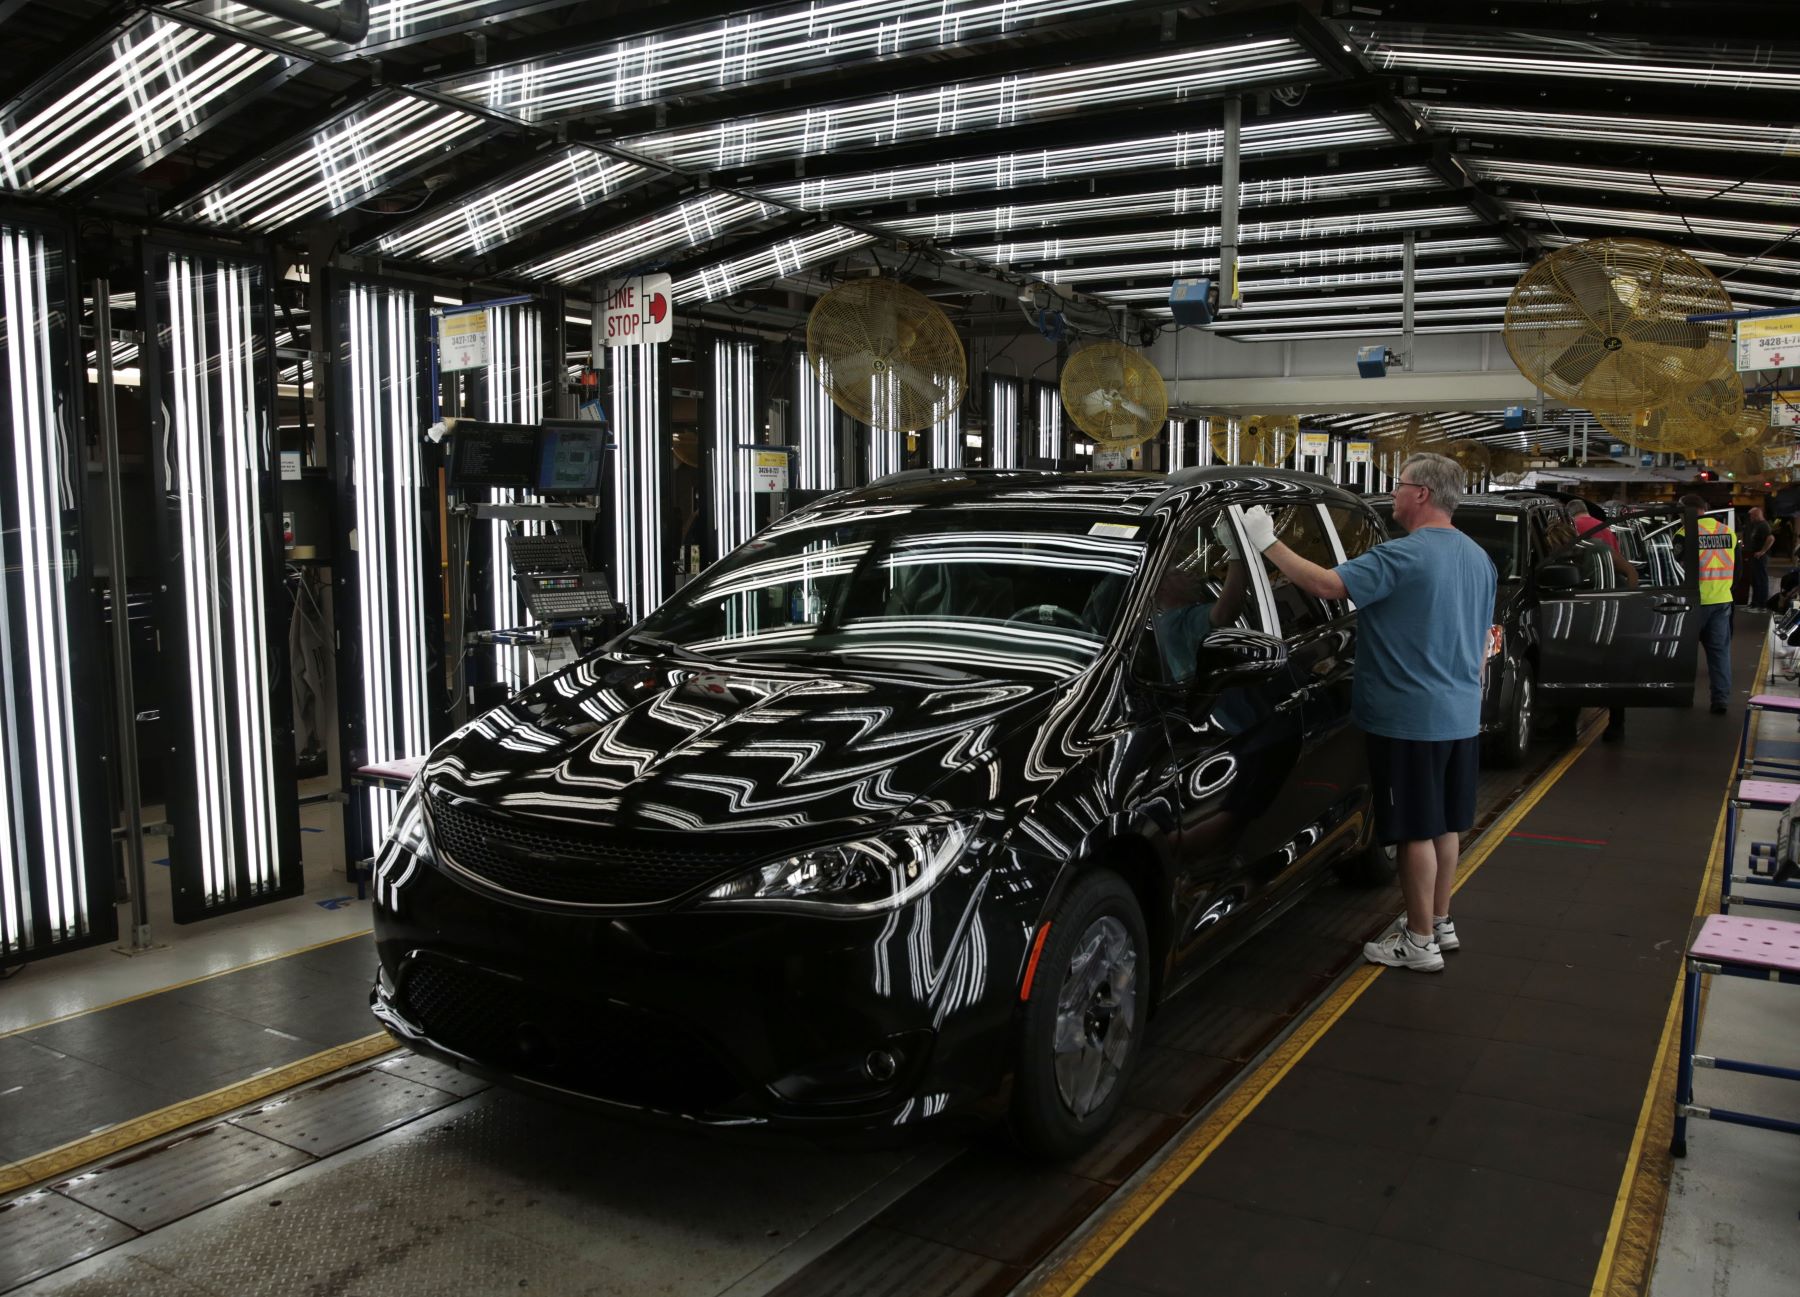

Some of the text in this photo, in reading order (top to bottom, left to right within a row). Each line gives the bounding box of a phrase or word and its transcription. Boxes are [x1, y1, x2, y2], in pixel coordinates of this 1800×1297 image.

[608, 287, 634, 310] LINE
[608, 314, 640, 337] STOP
[1699, 534, 1732, 549] SECURITY
[1393, 947, 1407, 959] N
